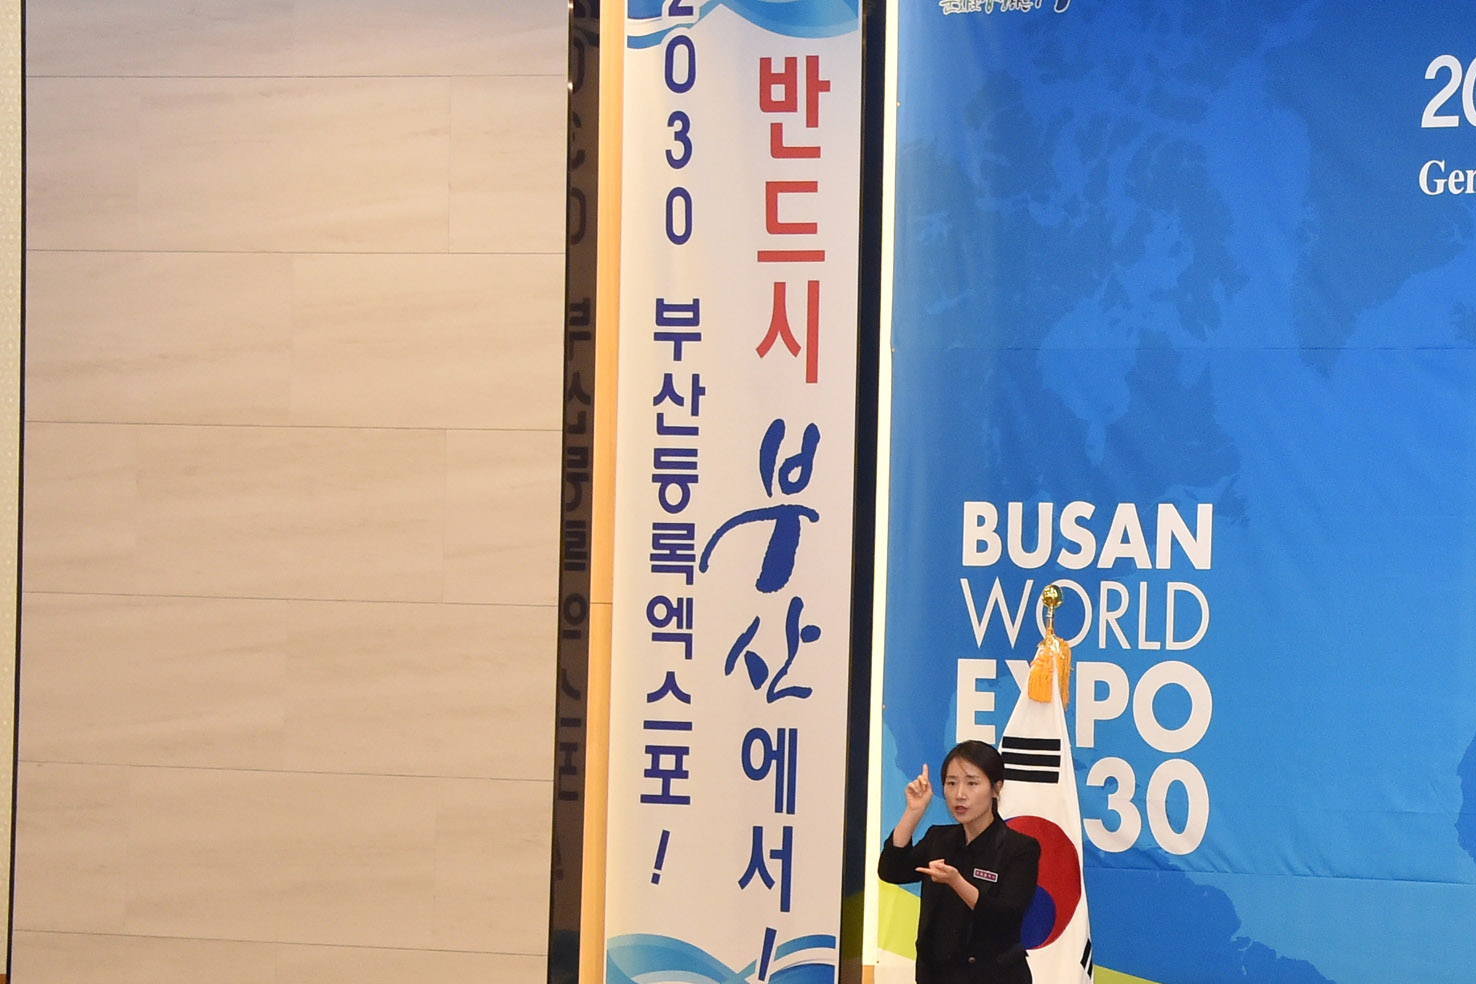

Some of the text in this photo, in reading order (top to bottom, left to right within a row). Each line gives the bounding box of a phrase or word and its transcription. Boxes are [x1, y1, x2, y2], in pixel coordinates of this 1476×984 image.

[756, 55, 831, 384] 반드시
[962, 500, 1213, 570] BUSAN
[960, 577, 1210, 651] WORLD
[955, 657, 1213, 754] EPO
[1083, 756, 1210, 856] 30
